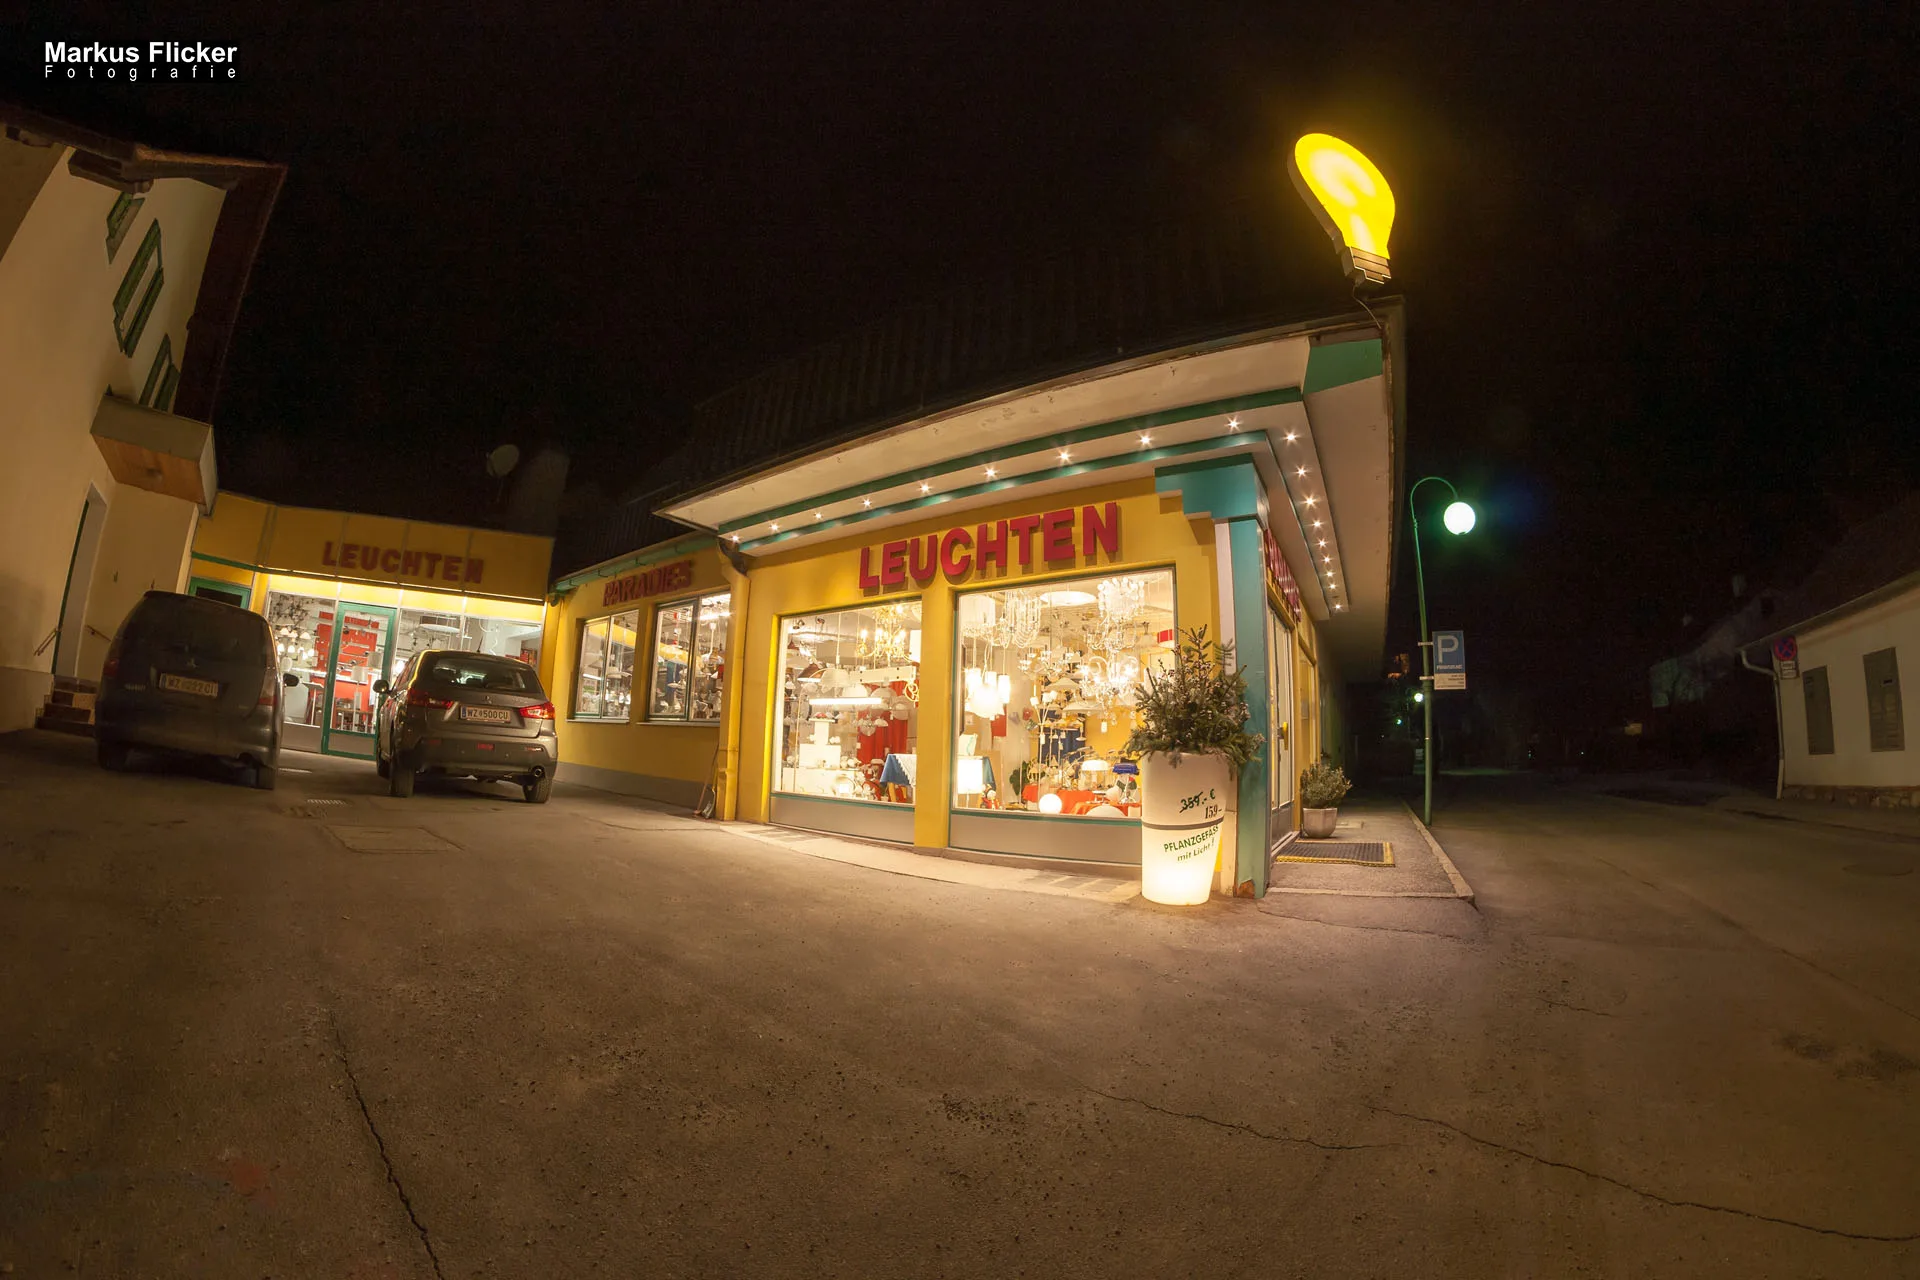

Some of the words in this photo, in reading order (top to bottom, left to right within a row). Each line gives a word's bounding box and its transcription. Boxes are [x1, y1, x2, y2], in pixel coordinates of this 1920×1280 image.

[322, 541, 484, 584] LEUCHTEN
[859, 502, 1118, 589] LEUCHTEN
[602, 559, 692, 607] PARADIES
[1437, 635, 1459, 664] P
[1177, 851, 1192, 861] mit
